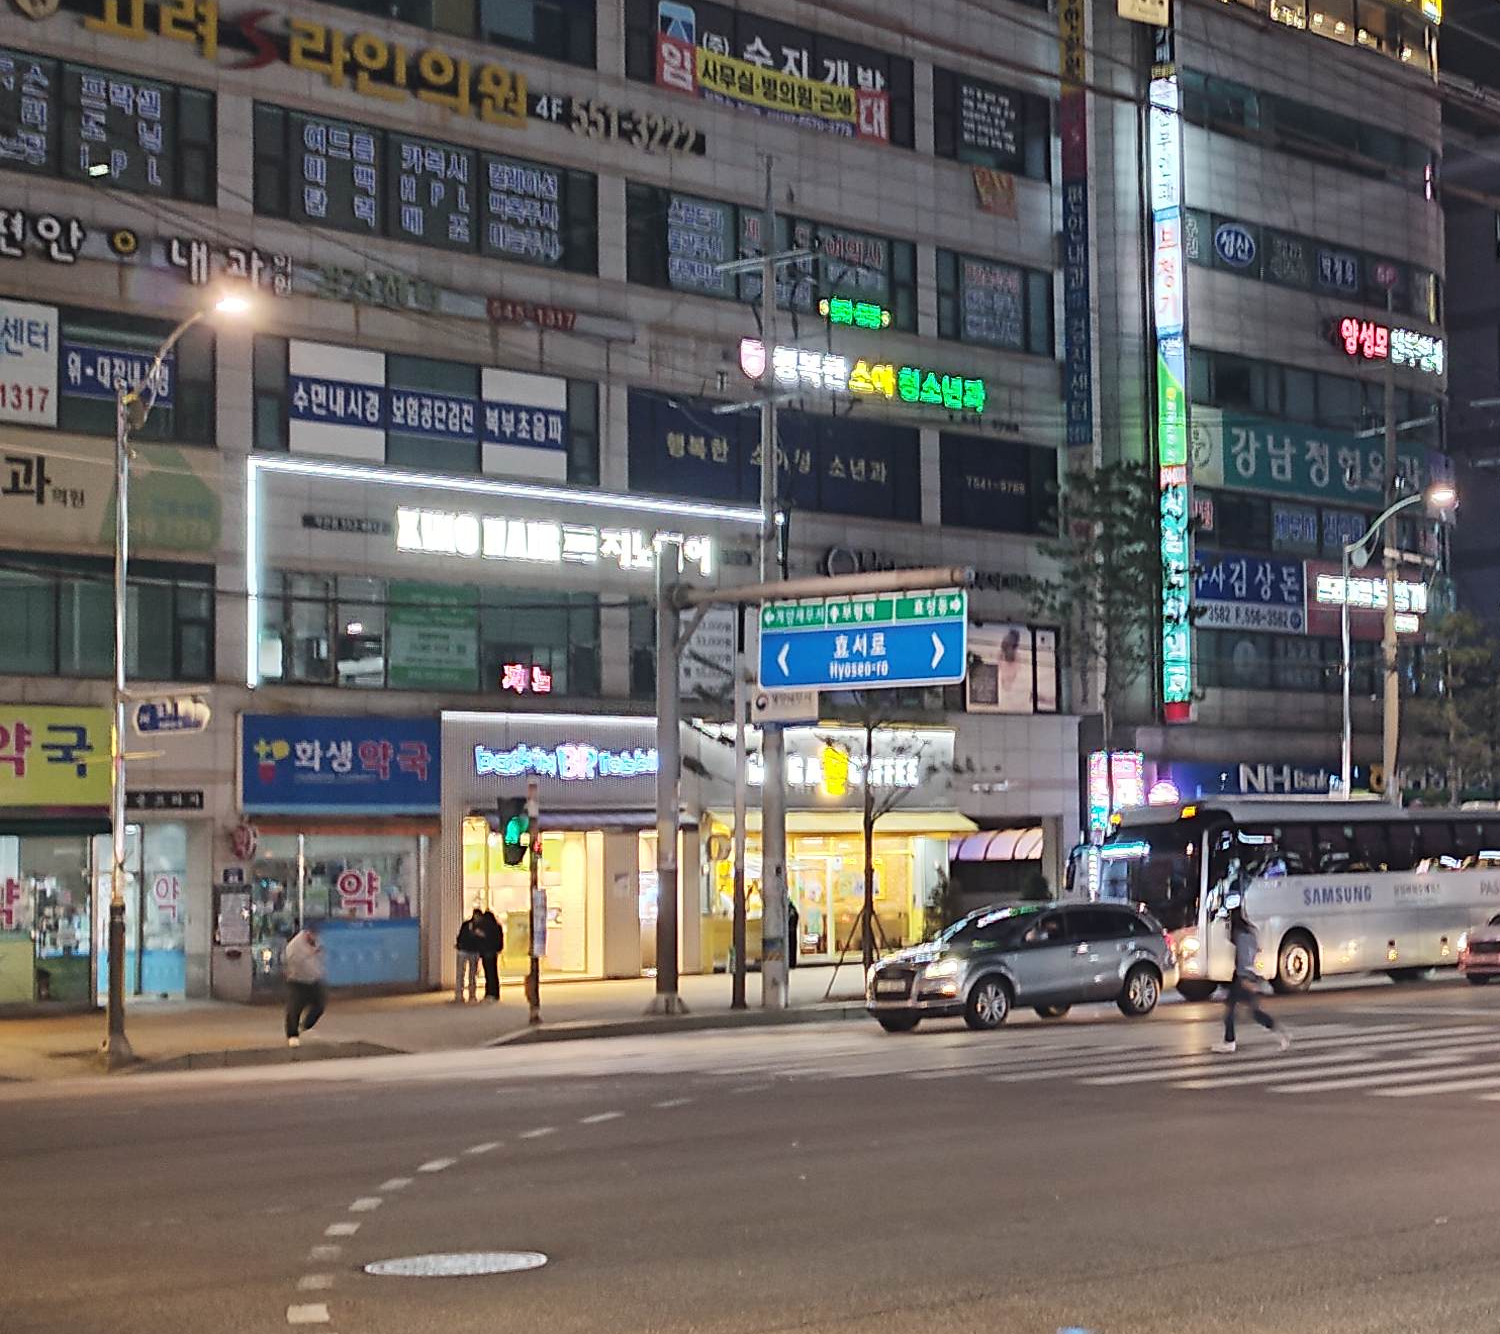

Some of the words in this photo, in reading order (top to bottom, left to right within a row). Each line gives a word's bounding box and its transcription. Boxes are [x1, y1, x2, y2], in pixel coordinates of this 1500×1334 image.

[535, 94, 563, 123] 4F
[859, 98, 887, 140] 대
[304, 124, 376, 164] 여드름
[293, 381, 381, 423] 수면내시경
[832, 632, 887, 659] 효서로
[828, 660, 889, 682] Hyoseo-ro
[1239, 763, 1292, 795] NH
[337, 869, 380, 916] 약
[1302, 885, 1373, 906] SAMSUNG
